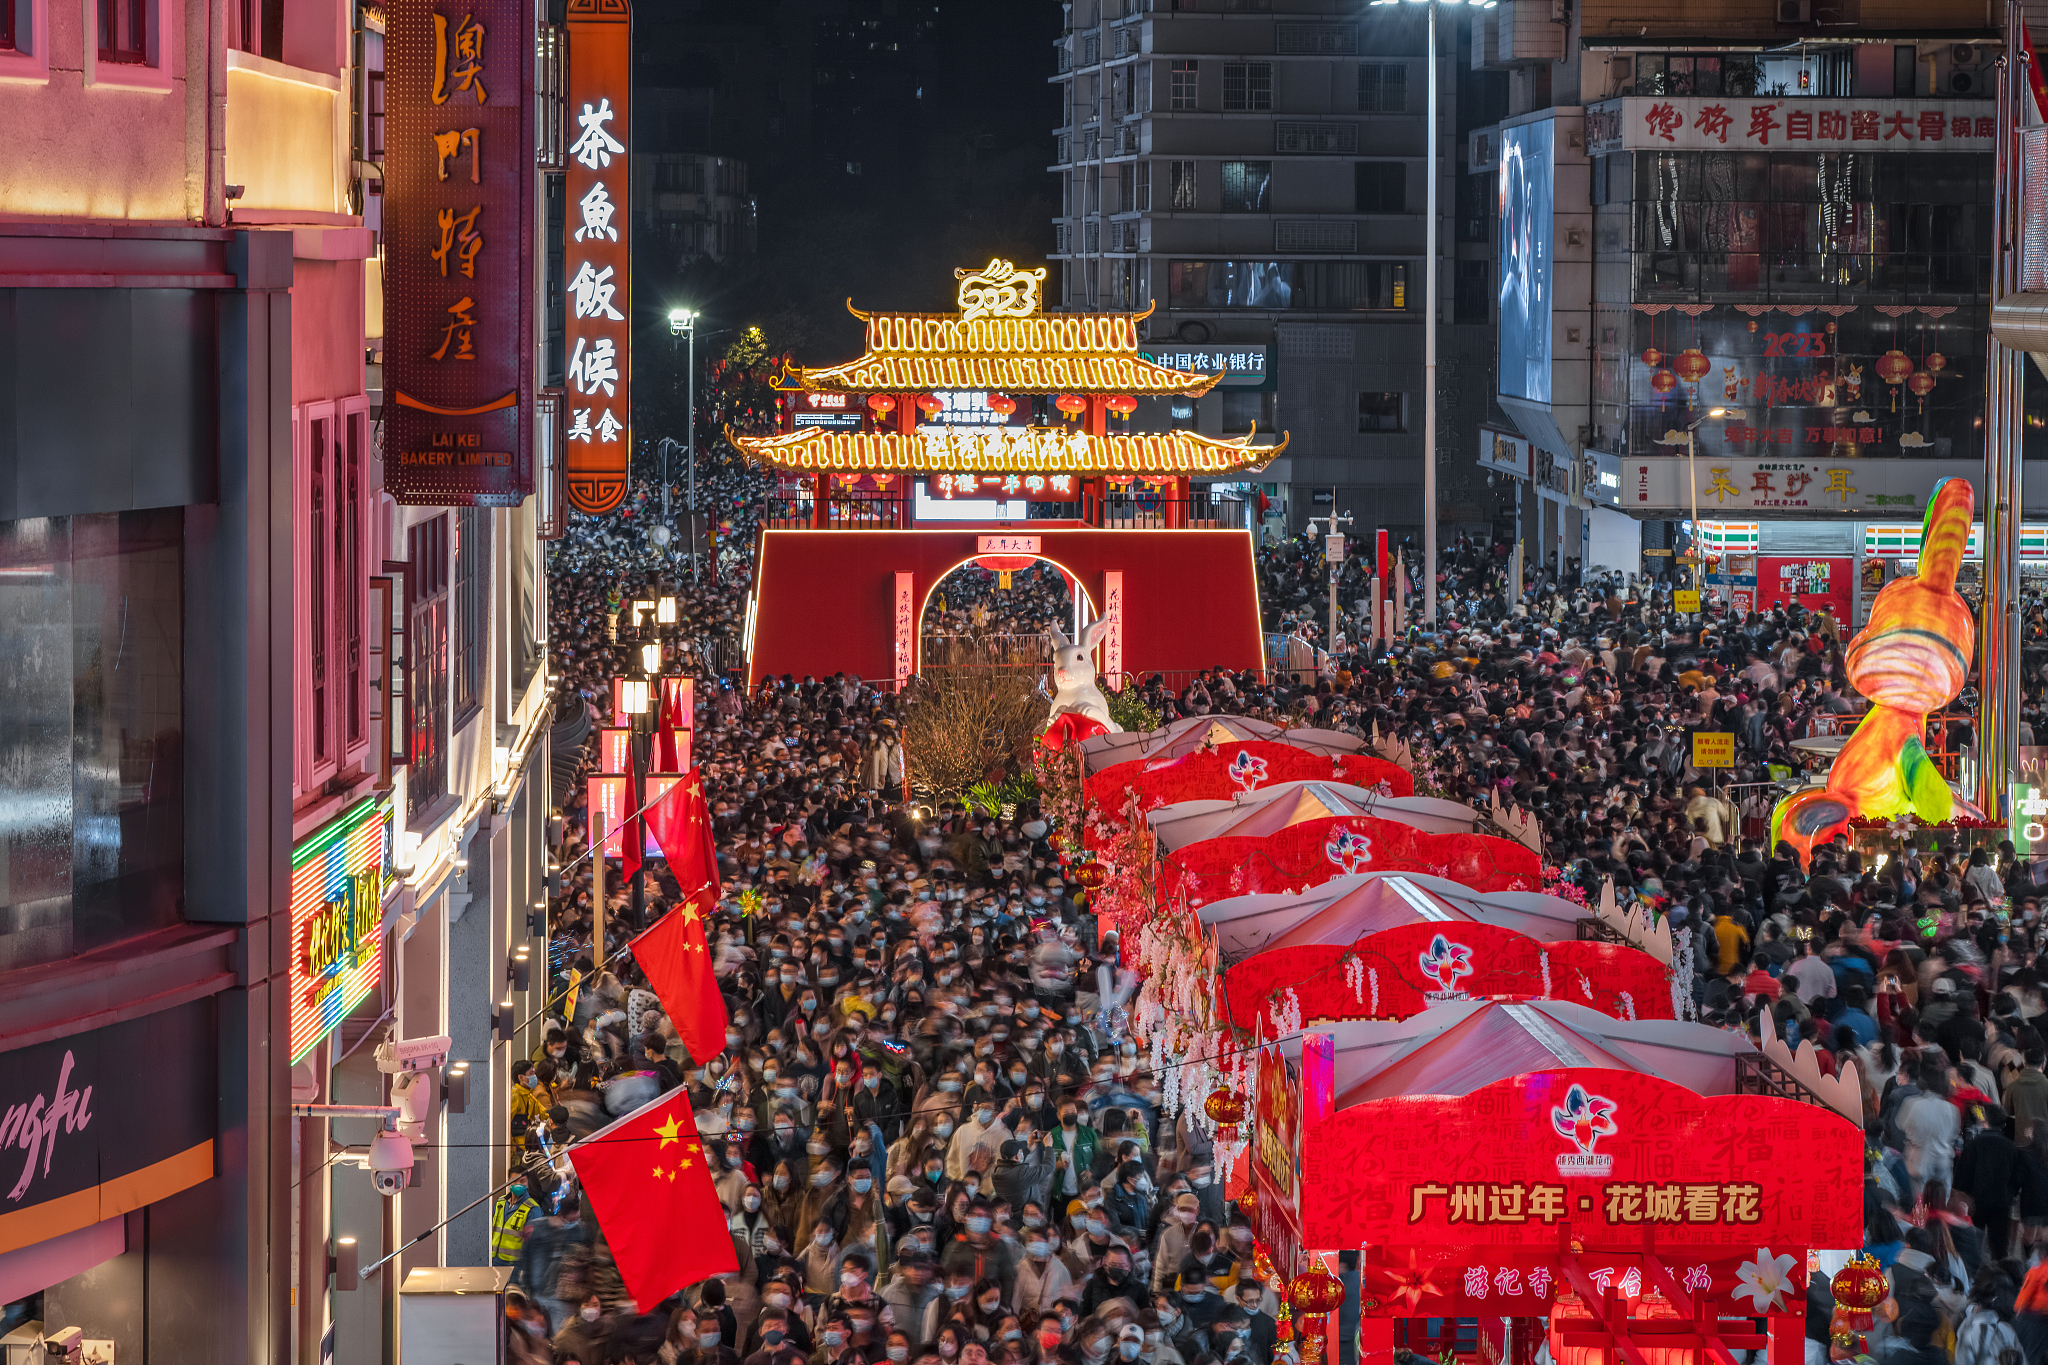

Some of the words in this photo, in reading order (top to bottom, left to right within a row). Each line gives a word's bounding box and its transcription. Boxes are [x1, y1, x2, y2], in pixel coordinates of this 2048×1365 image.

[567, 97, 627, 399] 茶魚飯候
[957, 271, 1038, 321] 2023
[1762, 331, 1827, 358] 2023
[1157, 352, 1265, 371] 中国农业银行
[1751, 369, 1836, 409] 新春快乐
[432, 433, 453, 447] LAI
[457, 433, 480, 447] KEI
[568, 408, 624, 444] 美食
[1724, 426, 1794, 444] 兔年大吉
[1804, 426, 1883, 444] 万事如意!
[400, 452, 453, 465] BAKERY
[457, 452, 512, 466] LIMITED
[1638, 465, 1649, 502] 请上二楼
